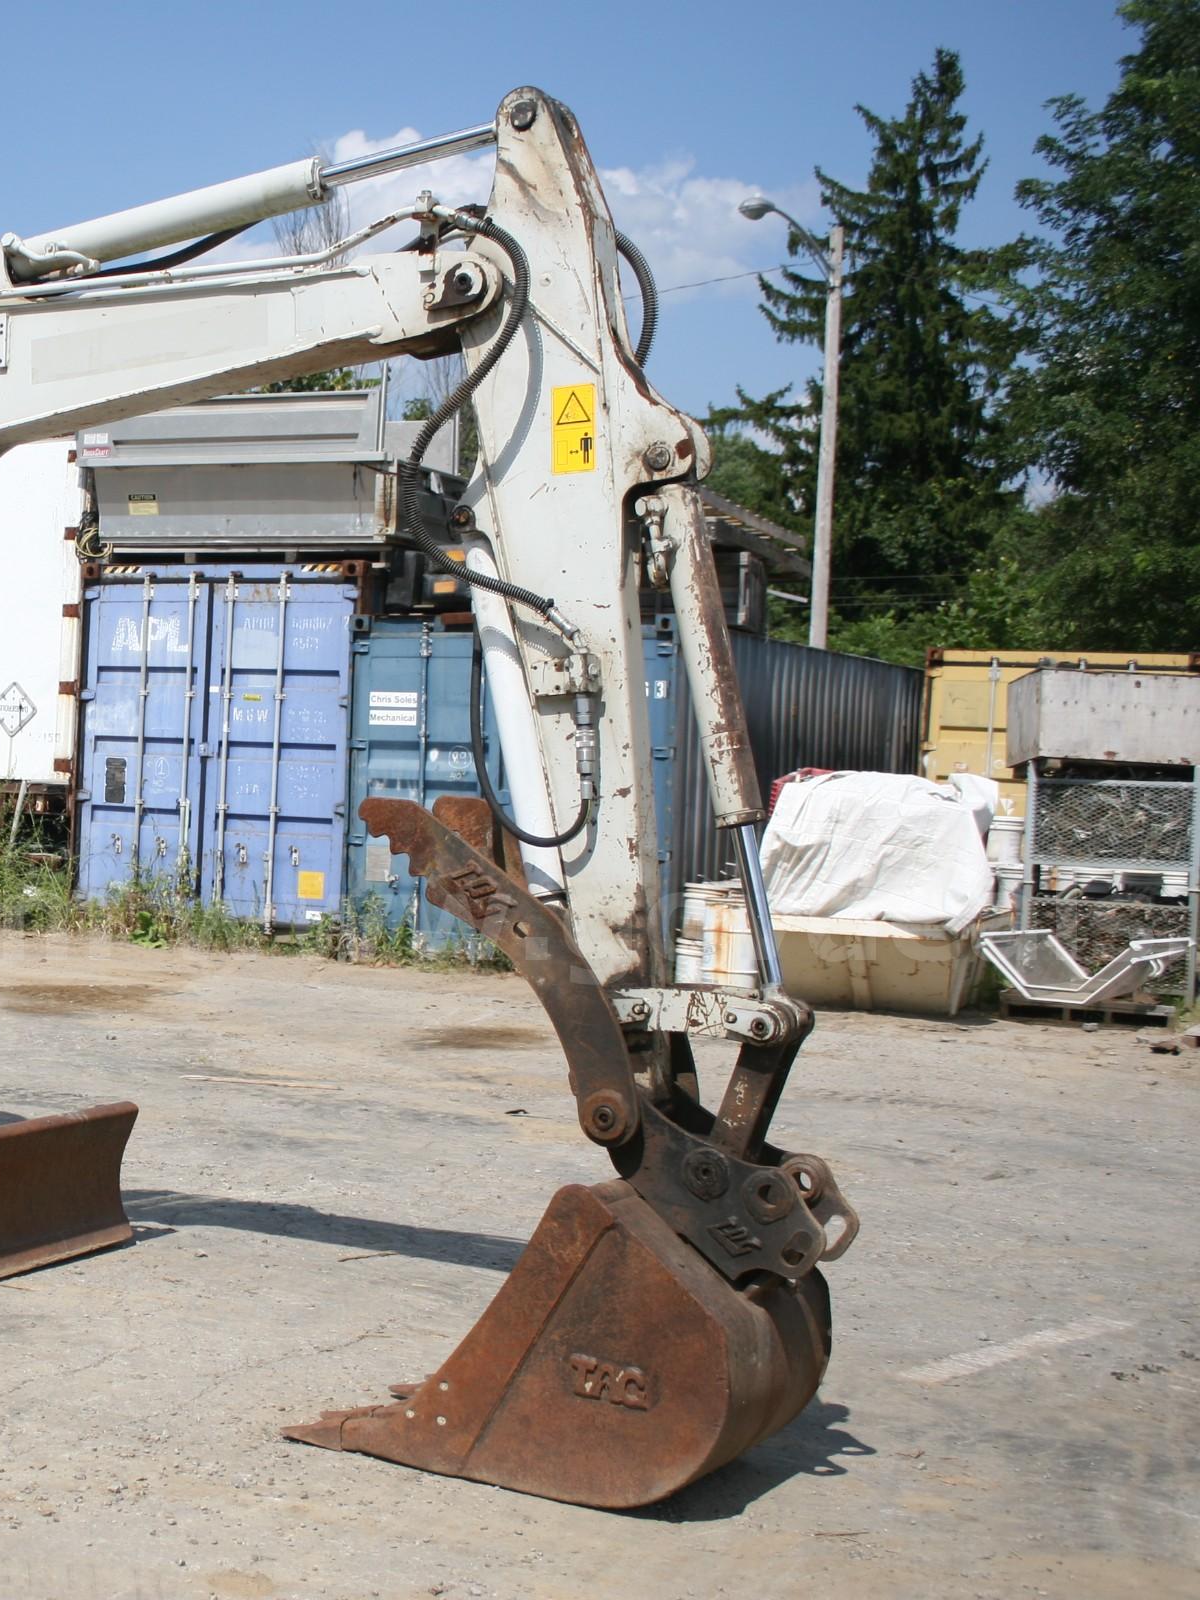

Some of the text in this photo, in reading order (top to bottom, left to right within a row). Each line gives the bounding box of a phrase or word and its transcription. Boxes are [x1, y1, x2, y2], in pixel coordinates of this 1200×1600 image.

[111, 615, 189, 652] APL
[370, 694, 417, 705] Chris Soles
[370, 713, 415, 722] Mechanical
